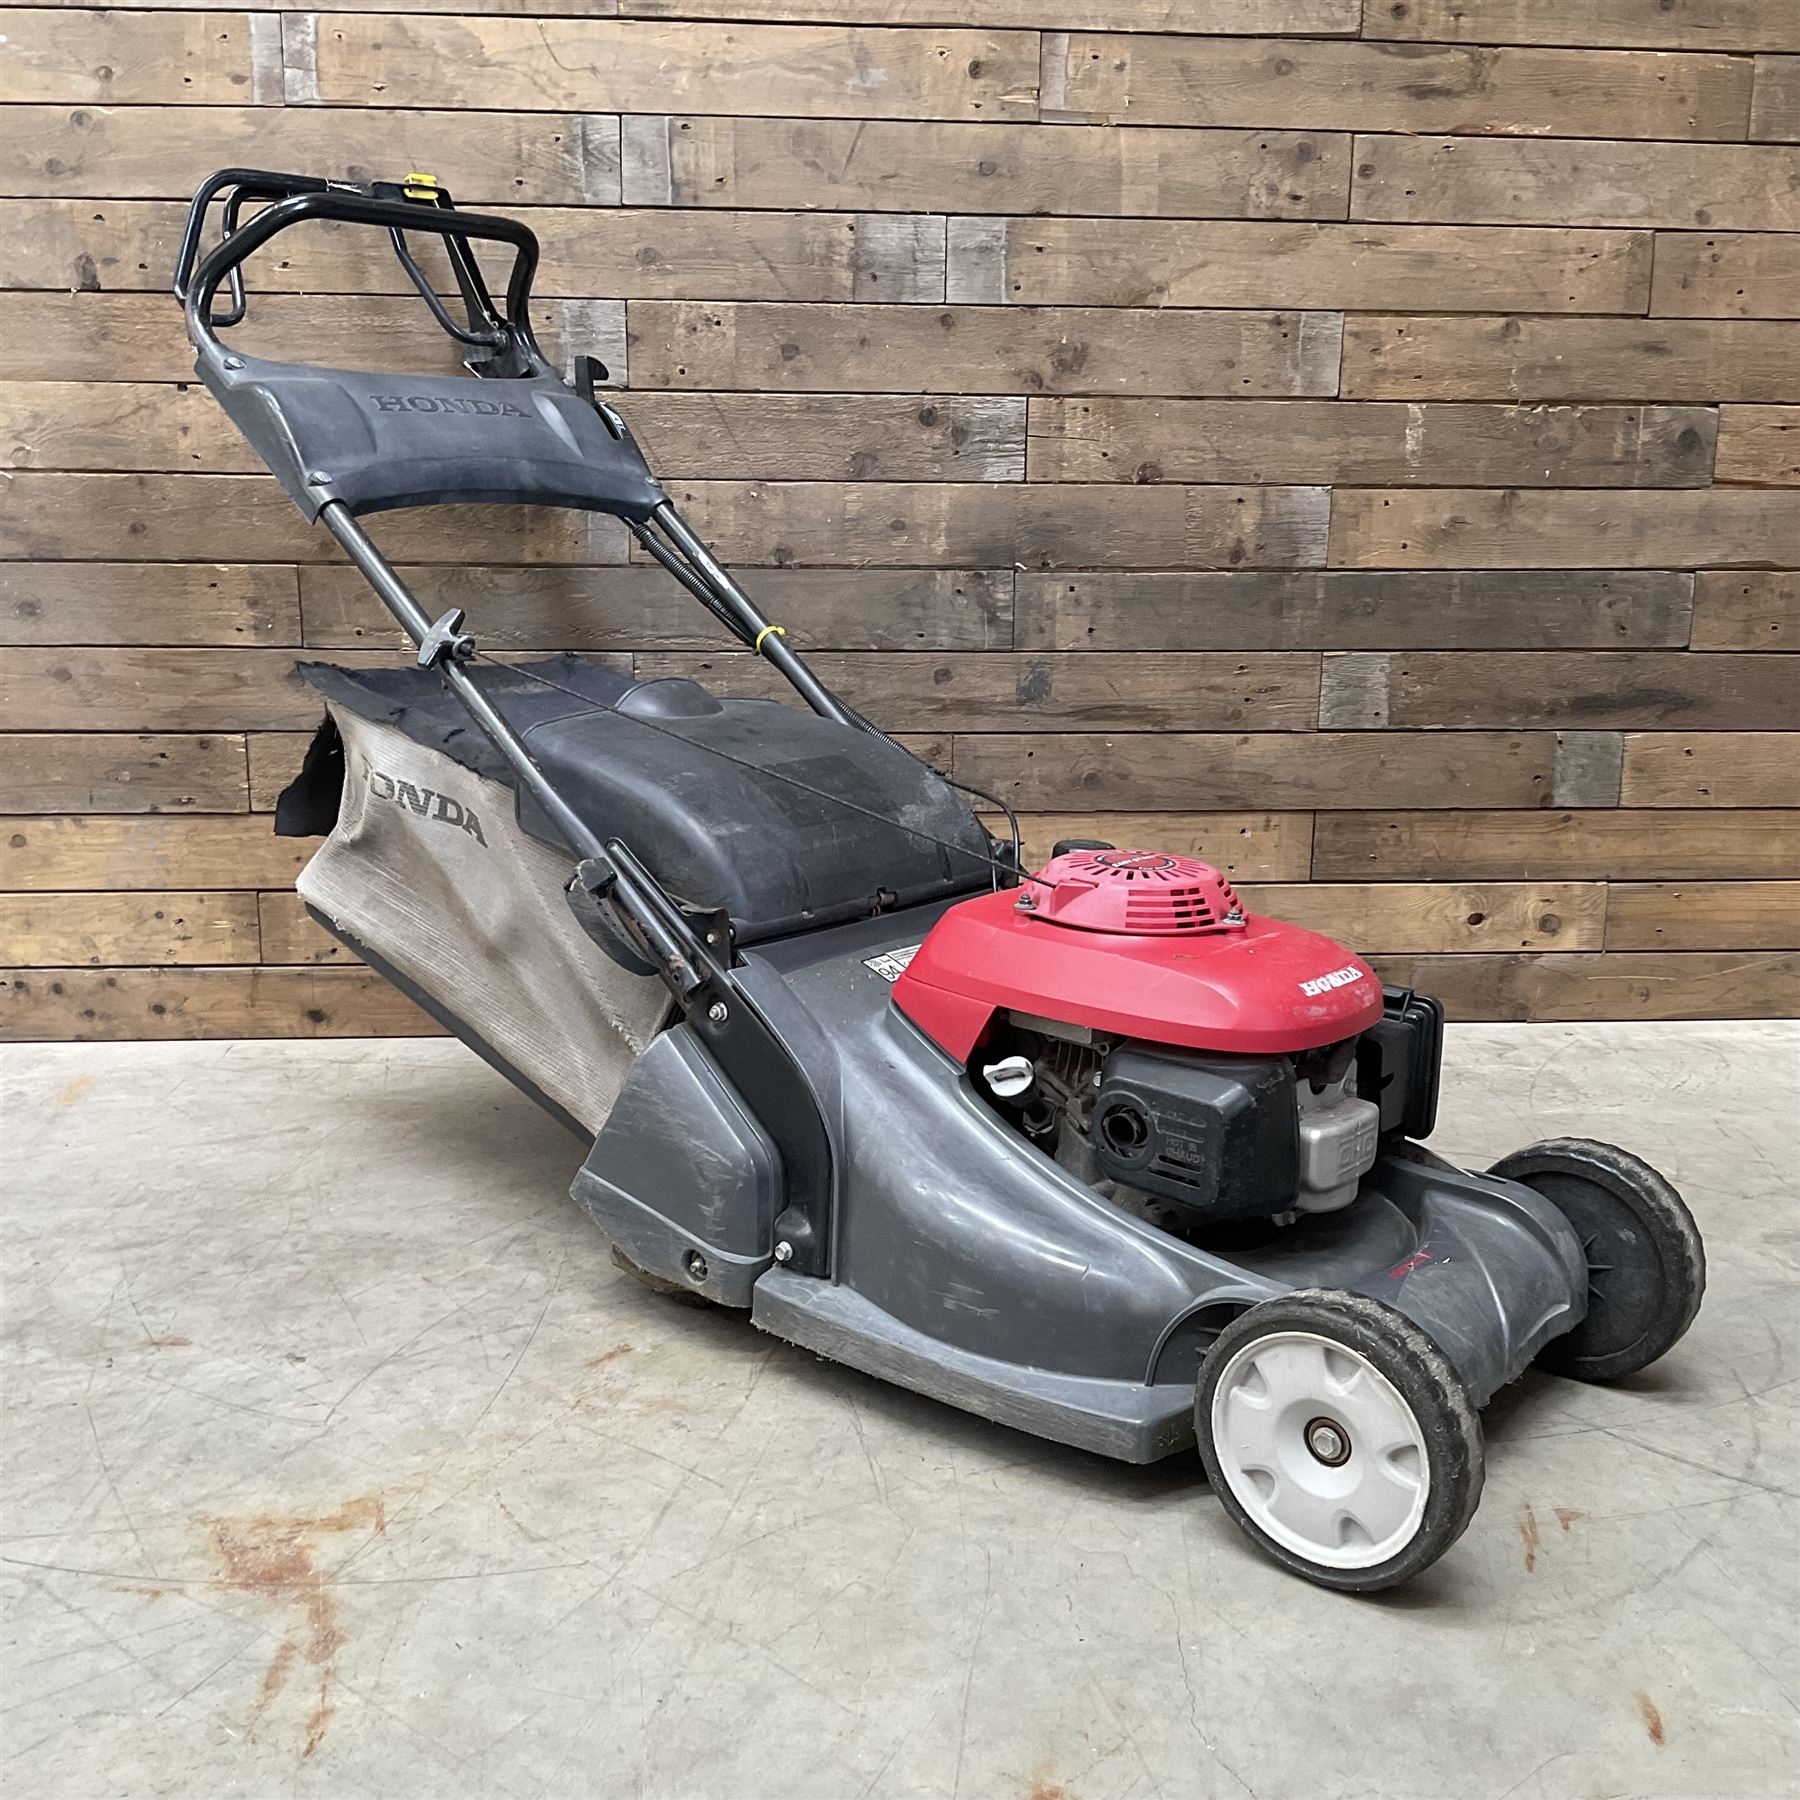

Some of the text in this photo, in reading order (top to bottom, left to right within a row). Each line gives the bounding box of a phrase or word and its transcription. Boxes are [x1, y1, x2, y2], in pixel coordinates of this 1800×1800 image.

[369, 395, 532, 418] HONDA
[361, 755, 488, 849] ONDA
[1298, 966, 1364, 997] HONDA
